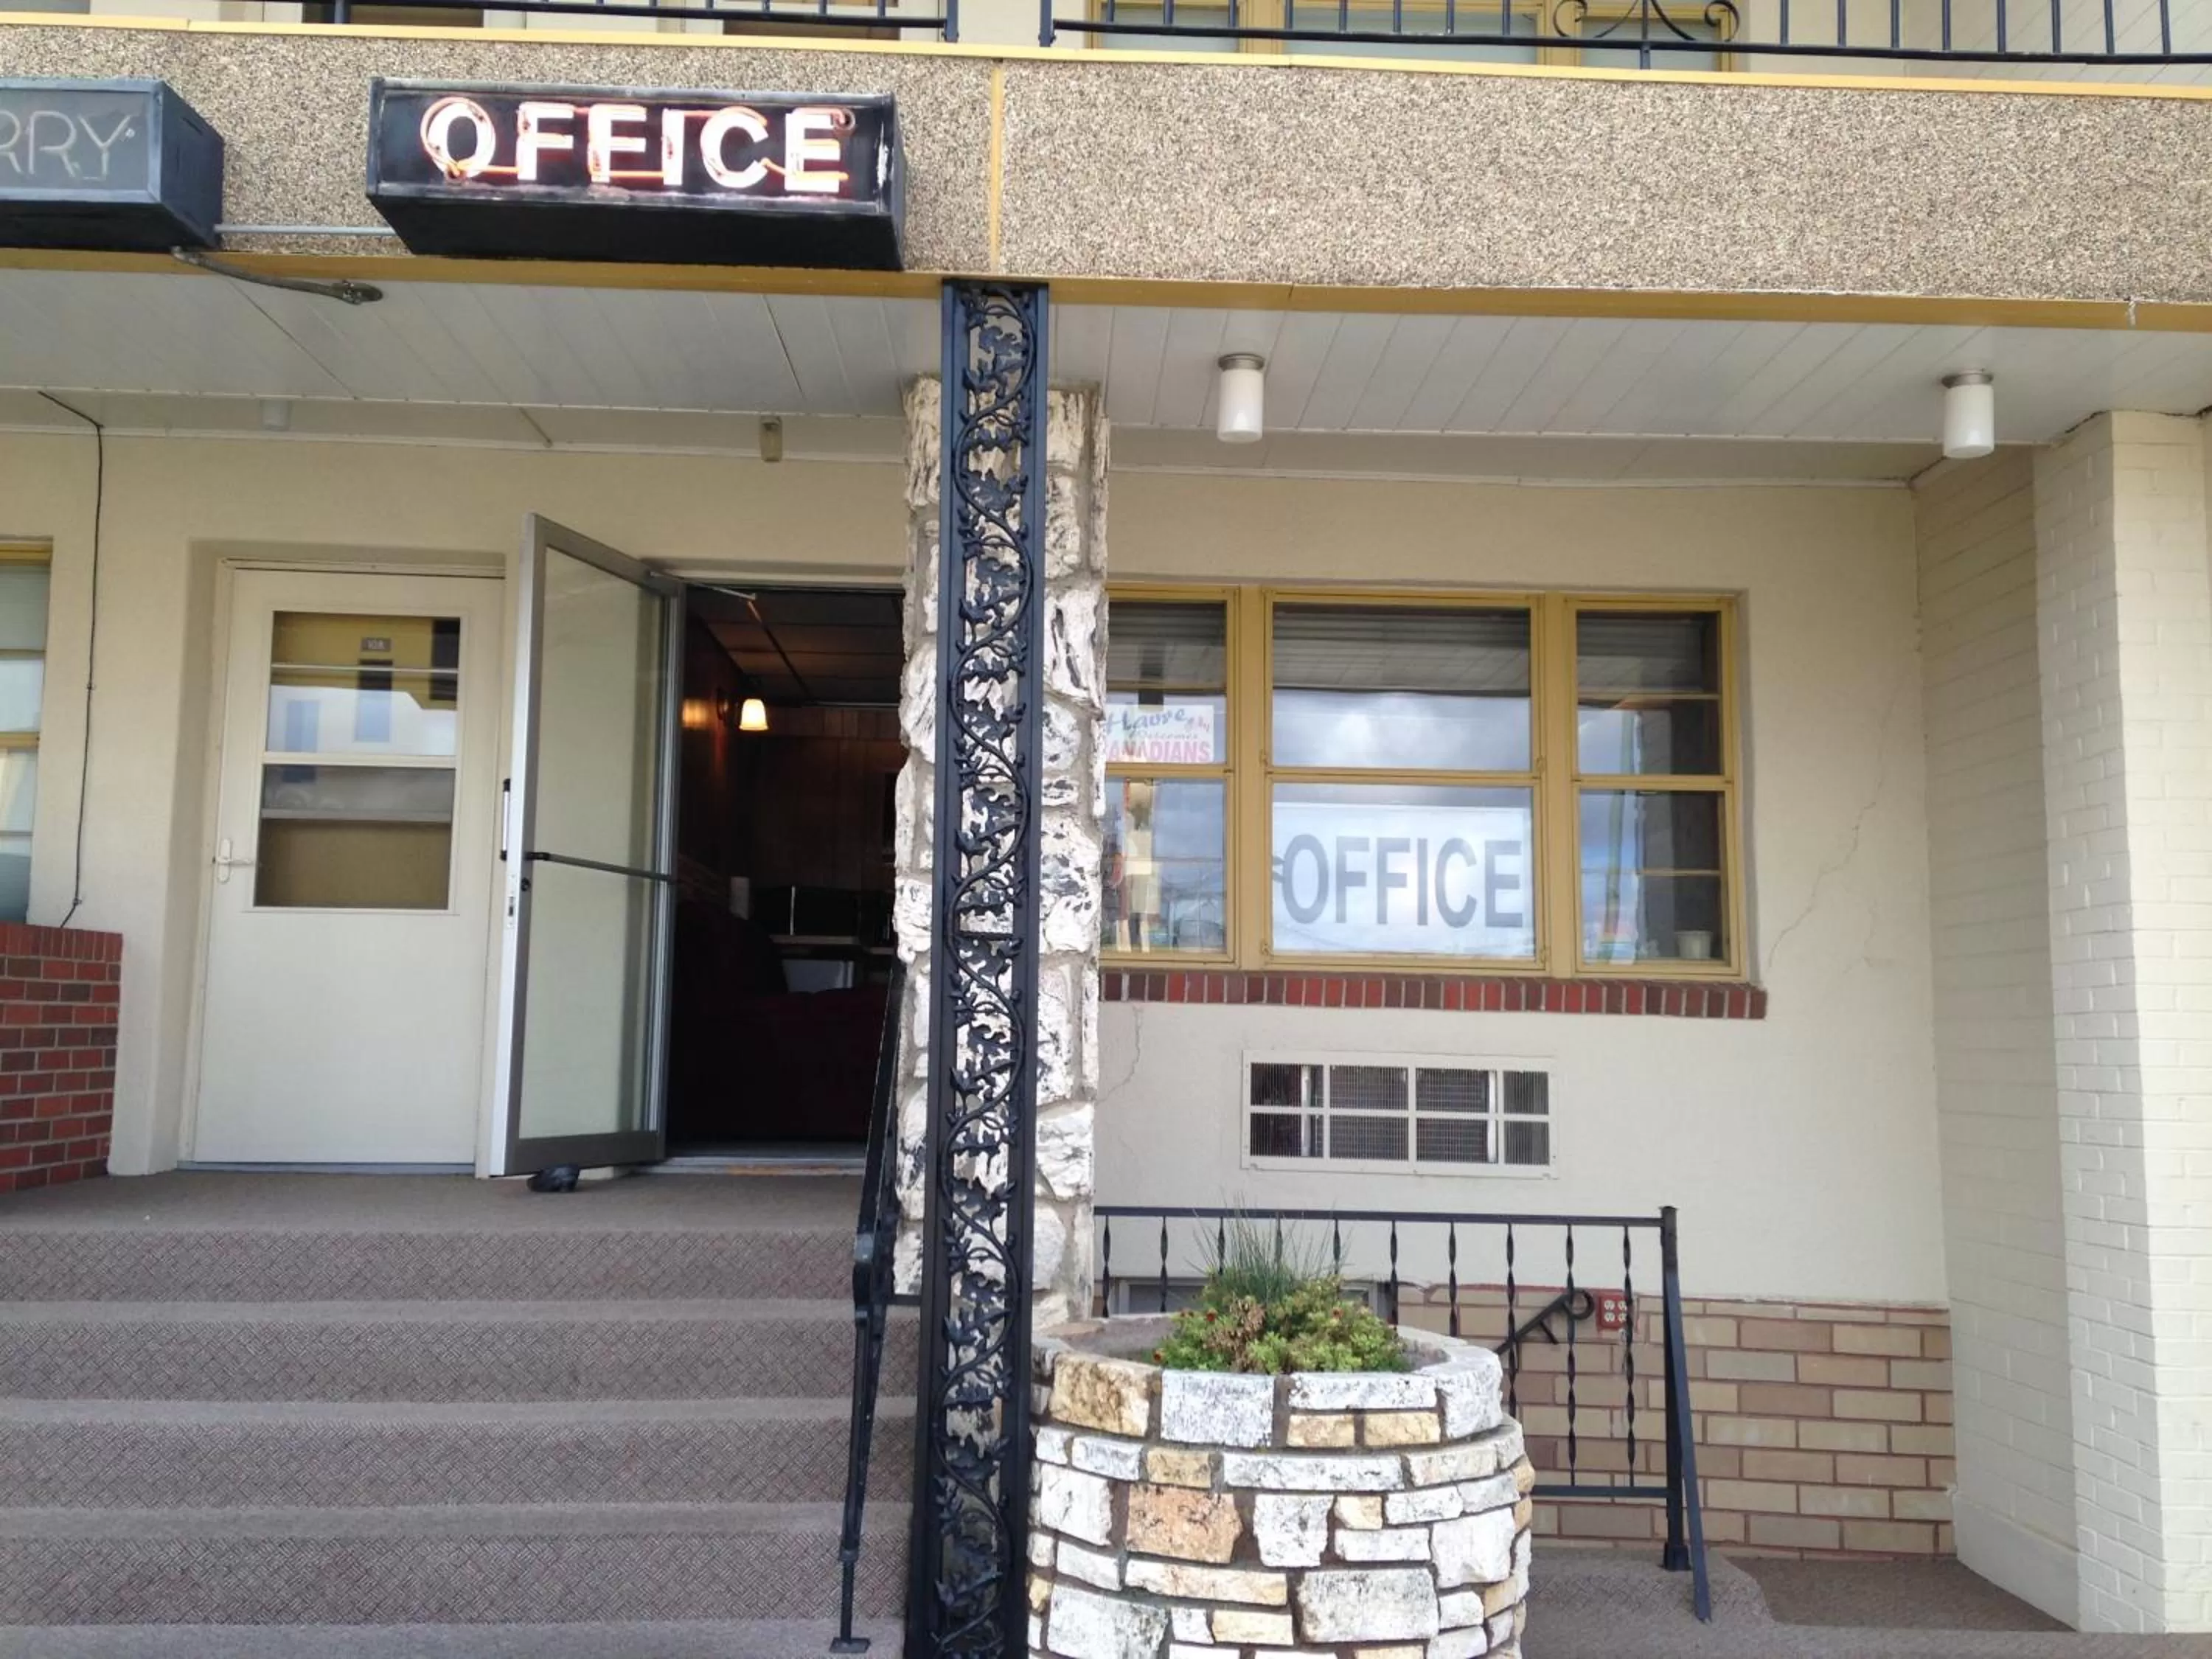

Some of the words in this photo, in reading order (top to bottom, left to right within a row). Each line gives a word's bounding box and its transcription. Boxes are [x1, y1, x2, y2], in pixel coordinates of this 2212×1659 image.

[422, 97, 850, 193] OFFICE
[1106, 740, 1211, 762] ANADIANS
[1282, 834, 1523, 928] OFFICE
